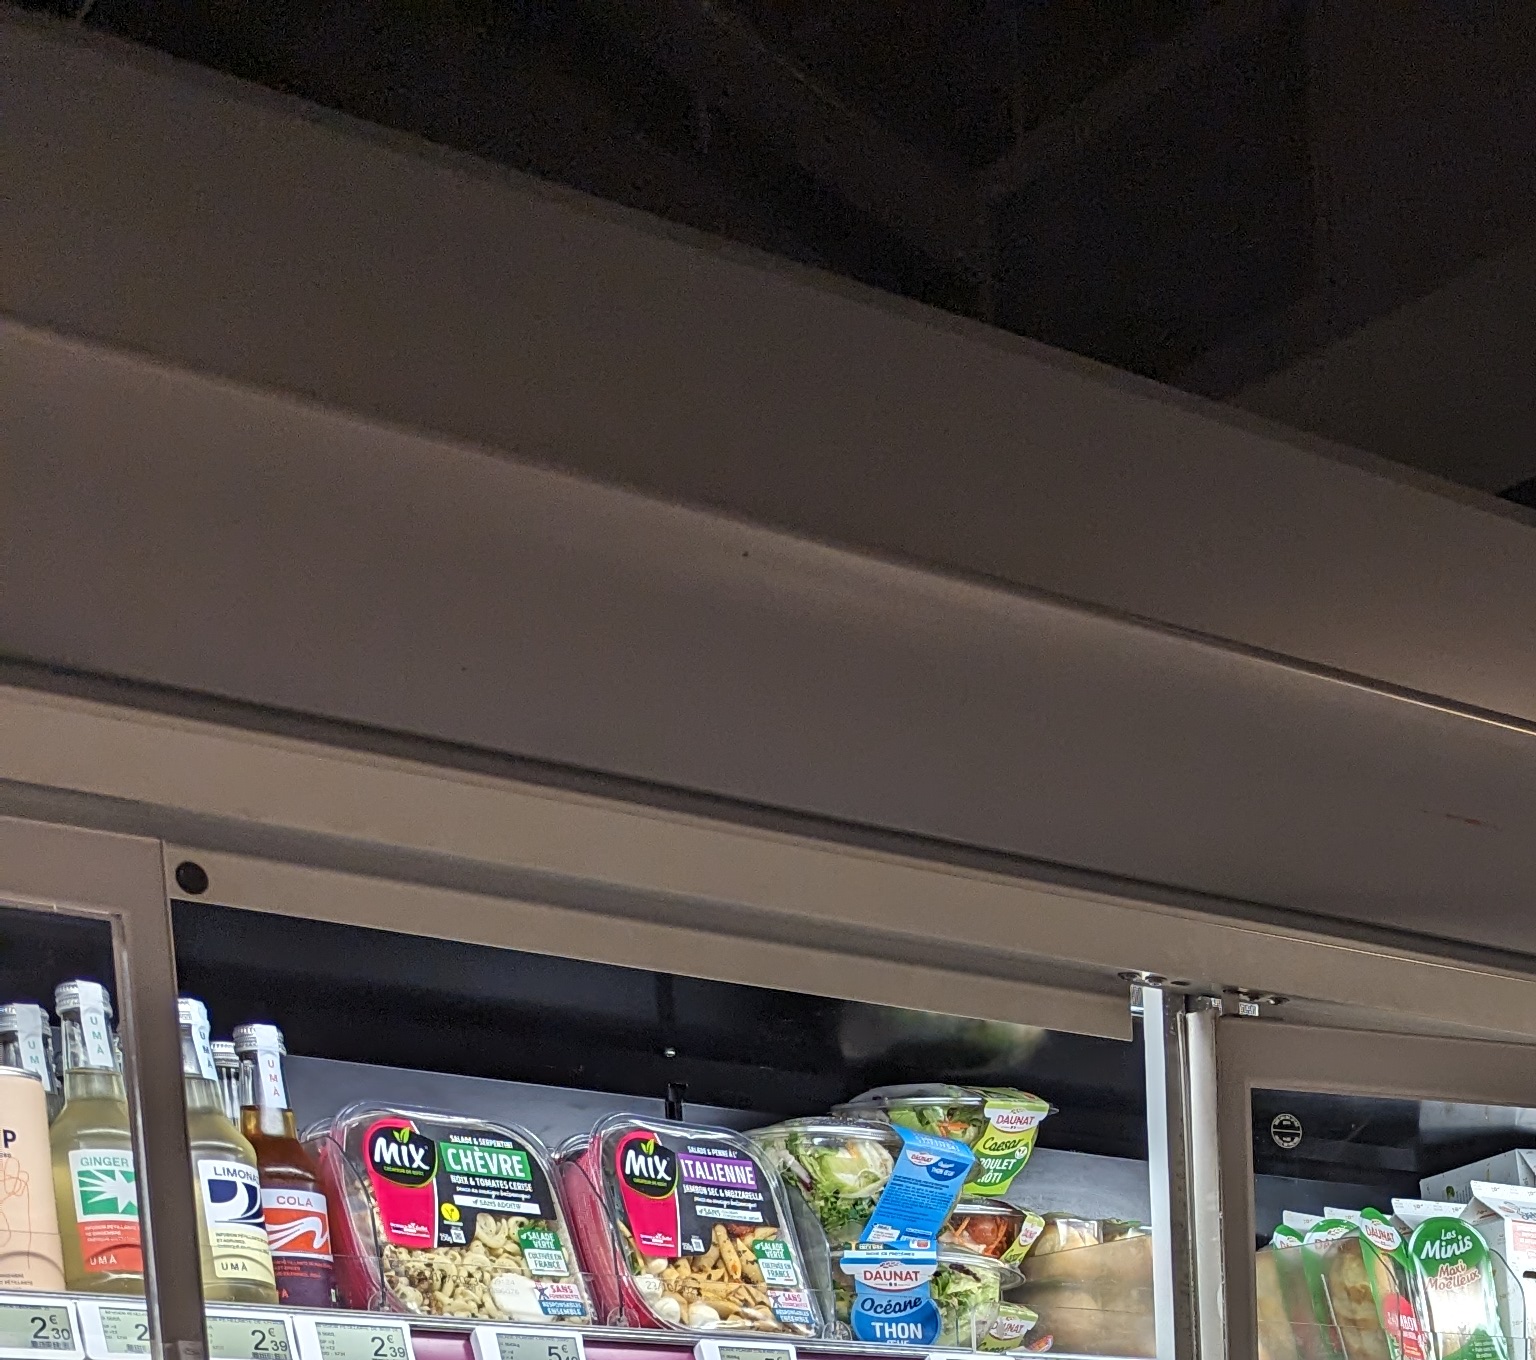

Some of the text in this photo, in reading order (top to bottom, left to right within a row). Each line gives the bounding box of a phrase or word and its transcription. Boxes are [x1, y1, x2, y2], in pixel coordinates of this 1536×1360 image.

[996, 1114, 1035, 1127] DAUNAT
[982, 1136, 1020, 1152] Caesar
[80, 1155, 129, 1168] GINGER
[447, 1147, 526, 1178] CHÈVRE
[680, 1158, 755, 1185] ITALIENNE
[276, 1195, 313, 1208] COLA
[1421, 1235, 1473, 1261] Minis
[863, 1269, 920, 1283] DAUNAT
[861, 1295, 922, 1315] Océane
[871, 1321, 923, 1340] THON
